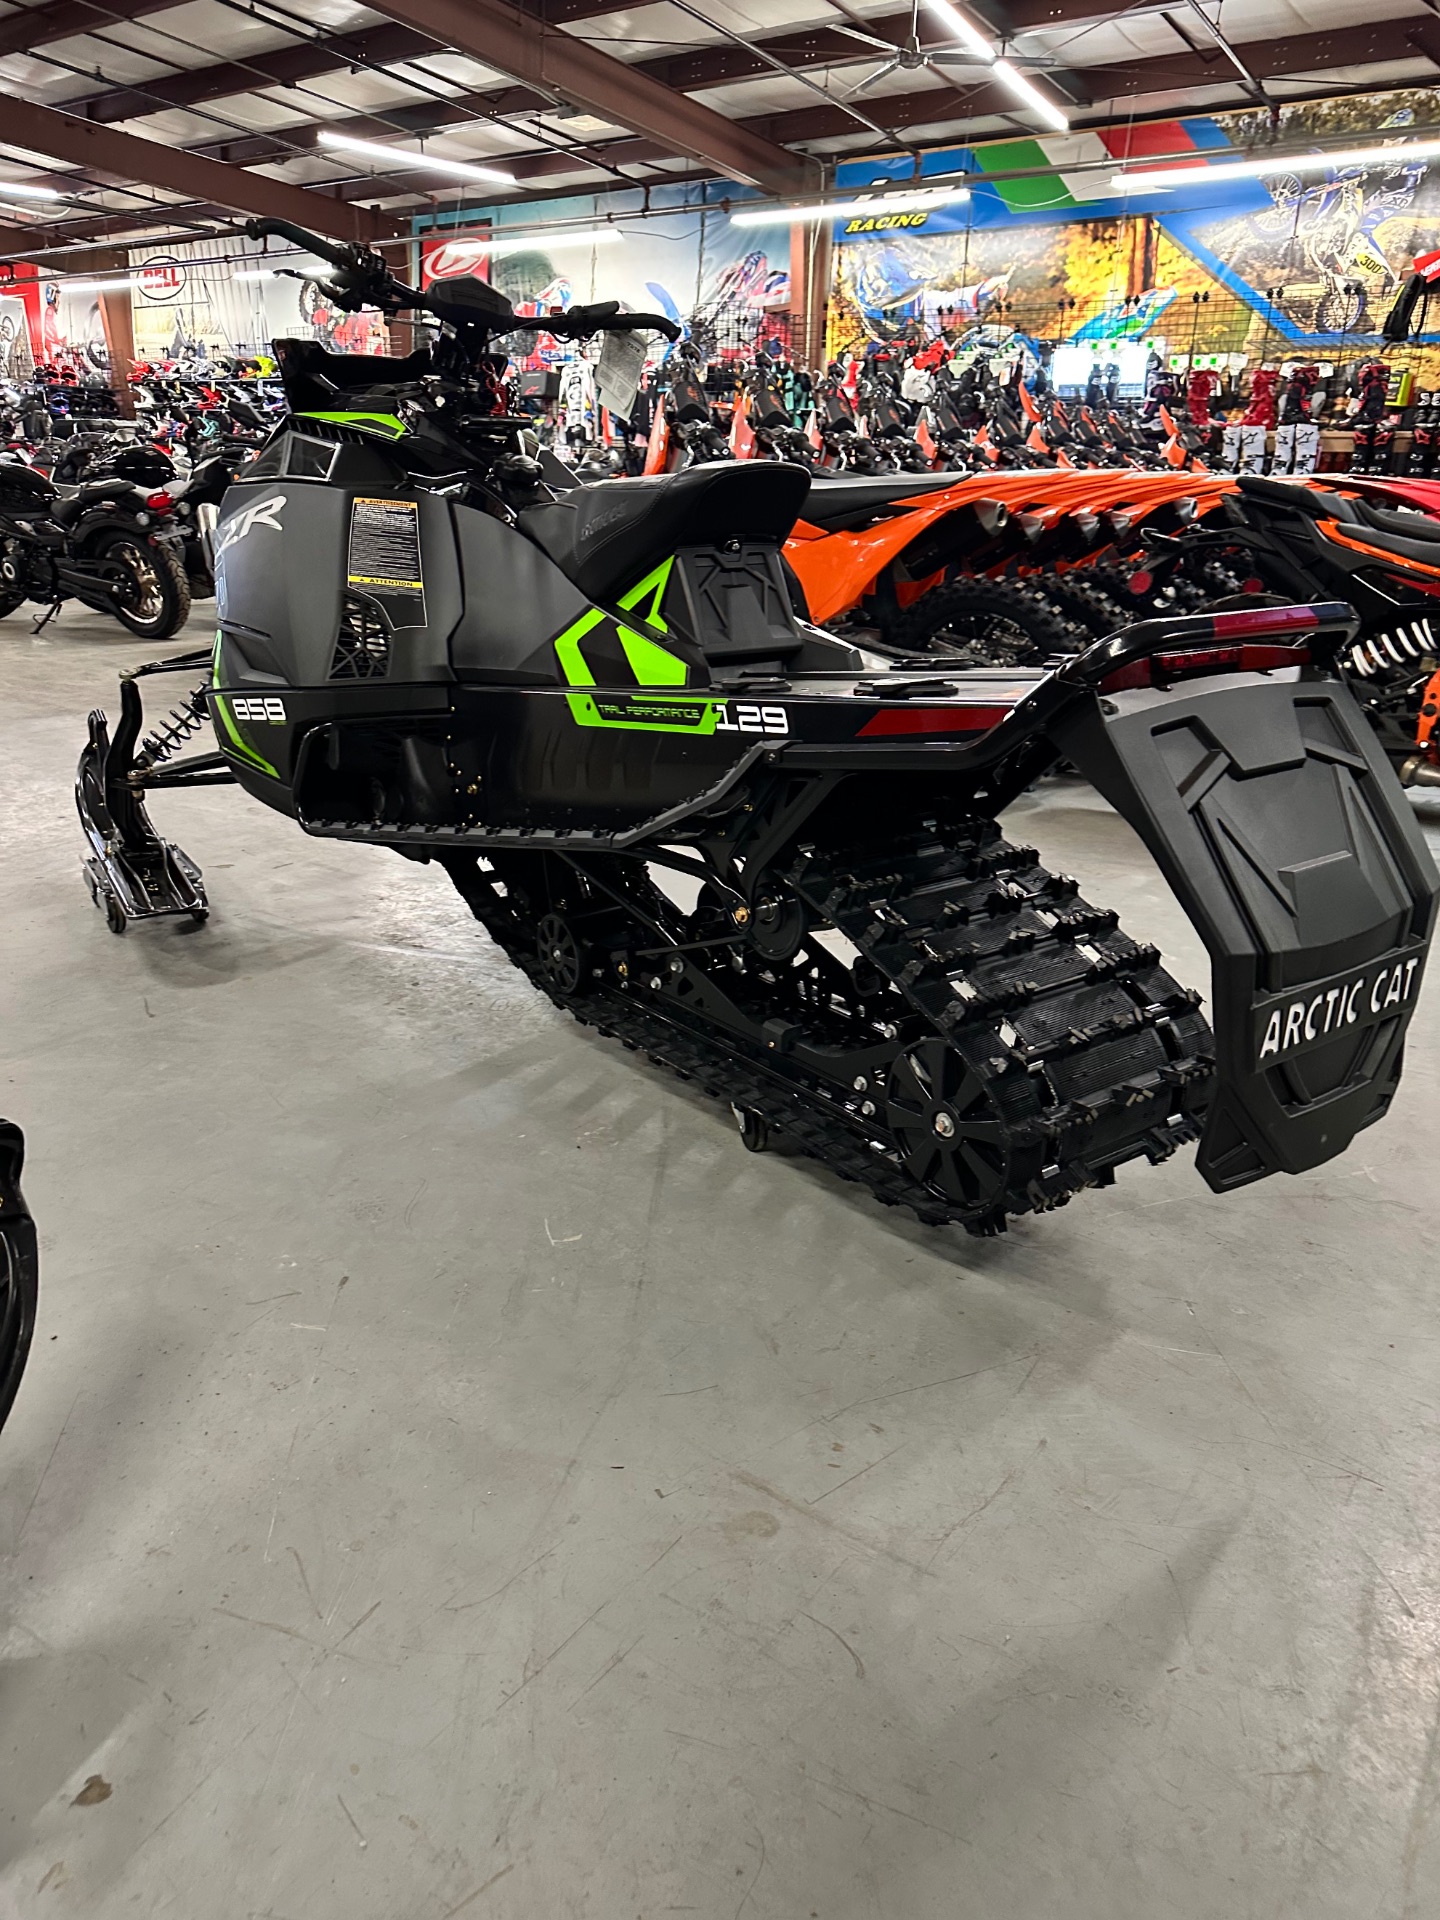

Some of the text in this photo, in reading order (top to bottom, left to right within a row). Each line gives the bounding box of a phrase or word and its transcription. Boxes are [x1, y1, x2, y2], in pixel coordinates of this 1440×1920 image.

[845, 213, 928, 233] RACING
[1360, 255, 1382, 275] 300
[369, 578, 413, 587] ATTENTION
[232, 698, 287, 721] 858
[716, 704, 789, 734] 129
[1259, 957, 1419, 1059] ARCTIC CAT
